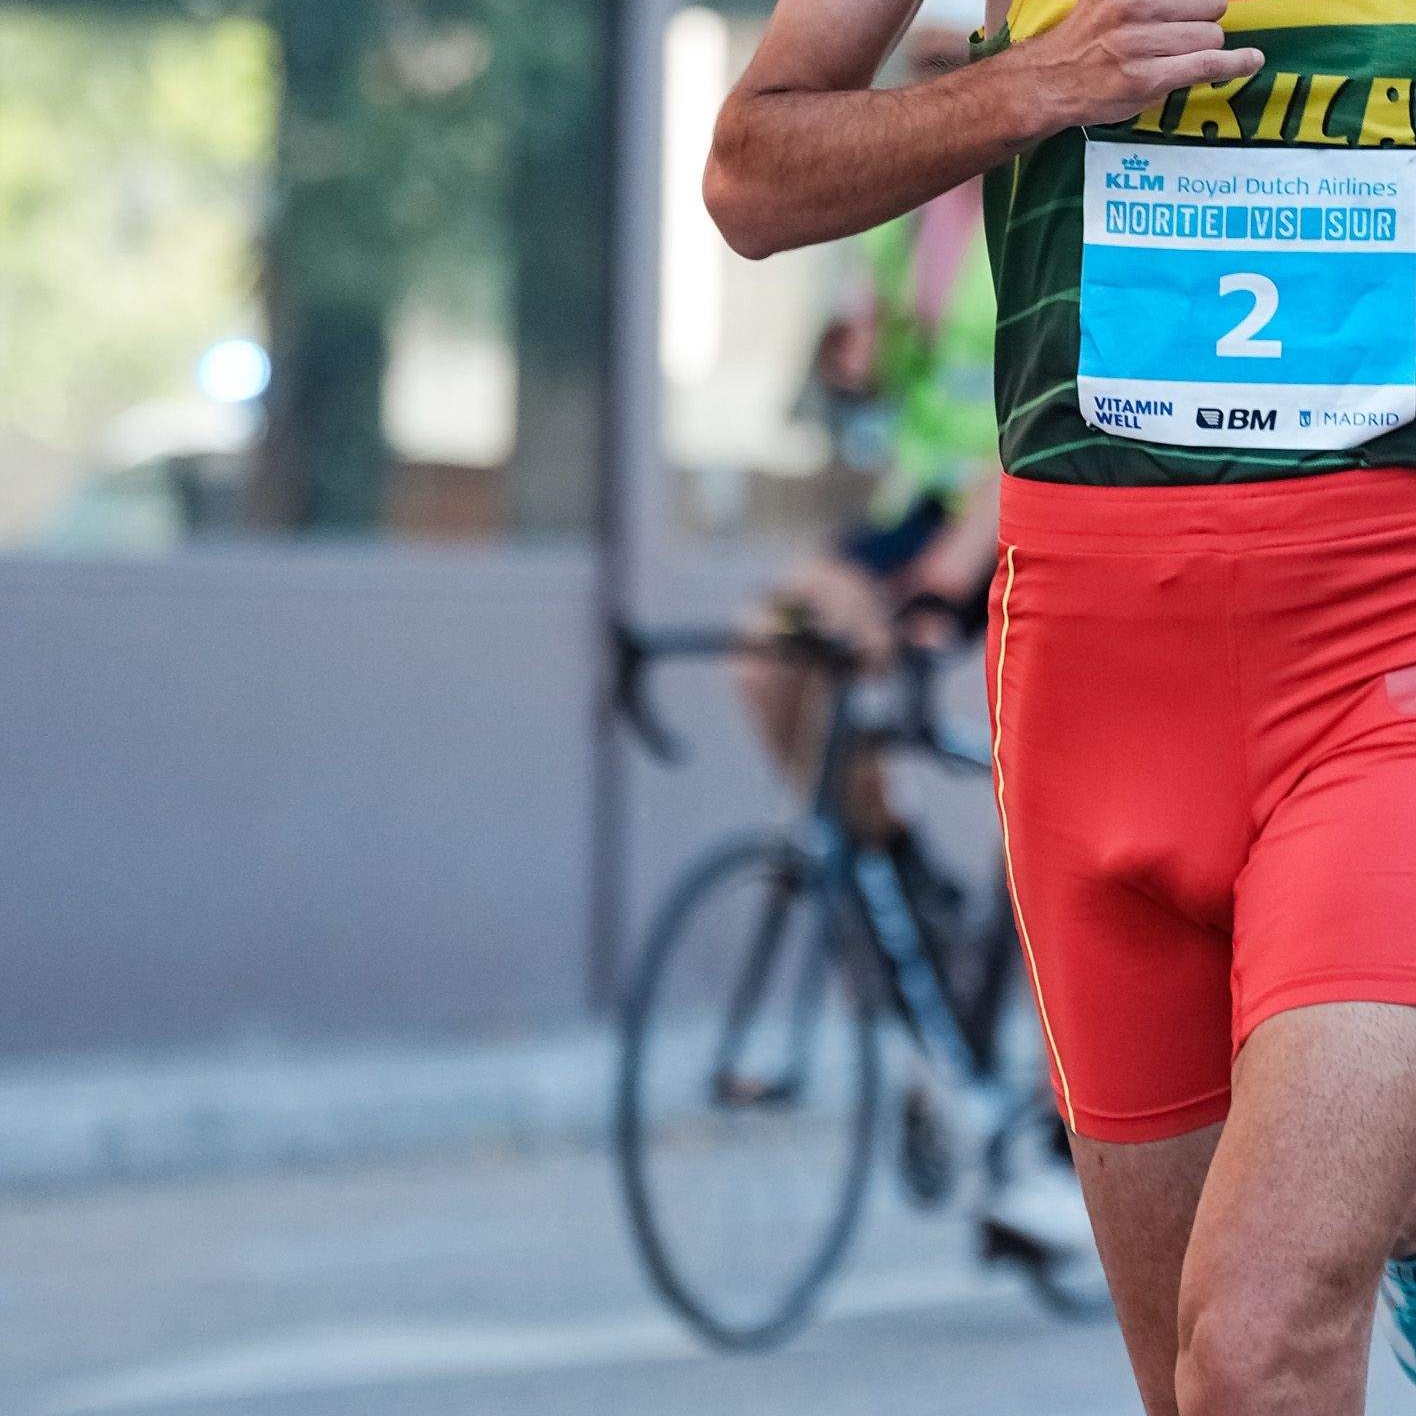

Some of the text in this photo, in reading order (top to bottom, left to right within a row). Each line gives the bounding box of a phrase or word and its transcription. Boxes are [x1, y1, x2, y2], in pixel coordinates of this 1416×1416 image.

[1106, 173, 1397, 198] KLM Royal Dutch Airlines
[1108, 202, 1393, 239] NORTE VS SUR
[1216, 273, 1282, 358] 2
[1093, 395, 1174, 416] VITAMIN
[1095, 411, 1142, 429] WELL
[1228, 408, 1277, 431] BM
[1324, 412, 1400, 426] MADRID
